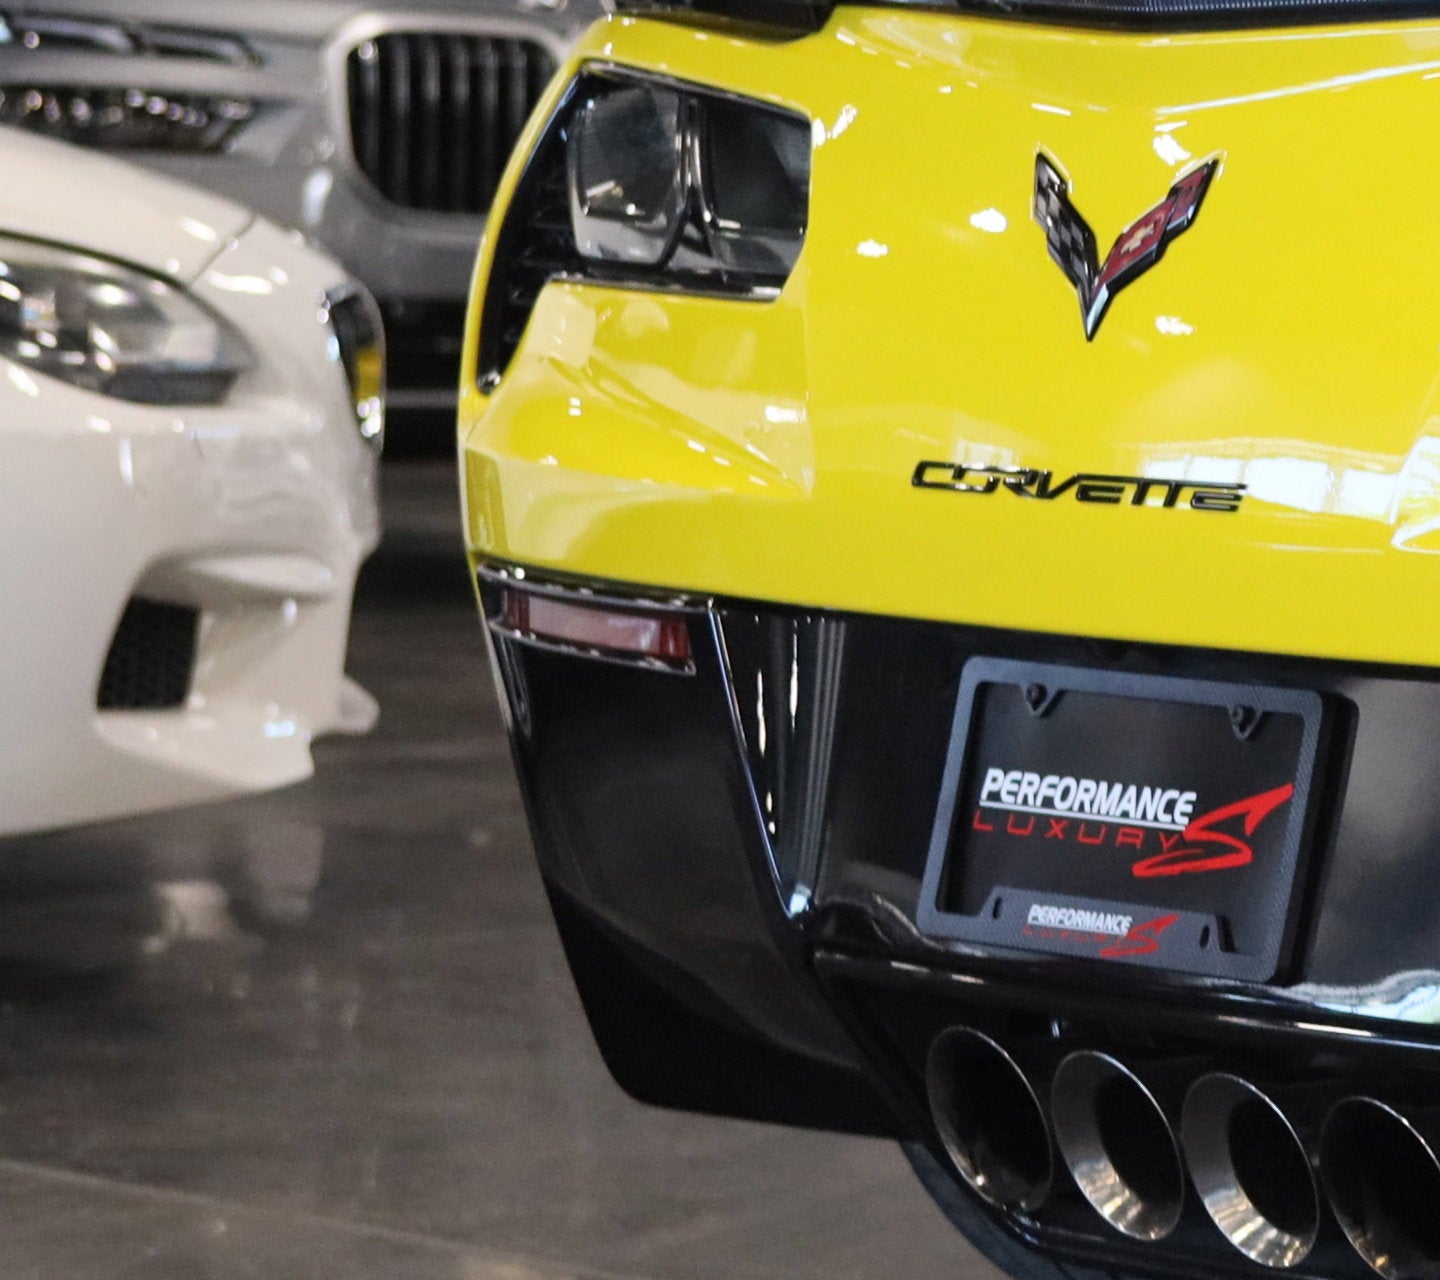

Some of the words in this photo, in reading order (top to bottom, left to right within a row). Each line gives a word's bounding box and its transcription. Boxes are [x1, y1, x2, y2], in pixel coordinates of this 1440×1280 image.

[911, 460, 1247, 512] CORVETTE
[980, 767, 1197, 825] PERFORMANCE
[973, 809, 1182, 852] LUXURY
[1028, 904, 1133, 934] PERFORMANCE
